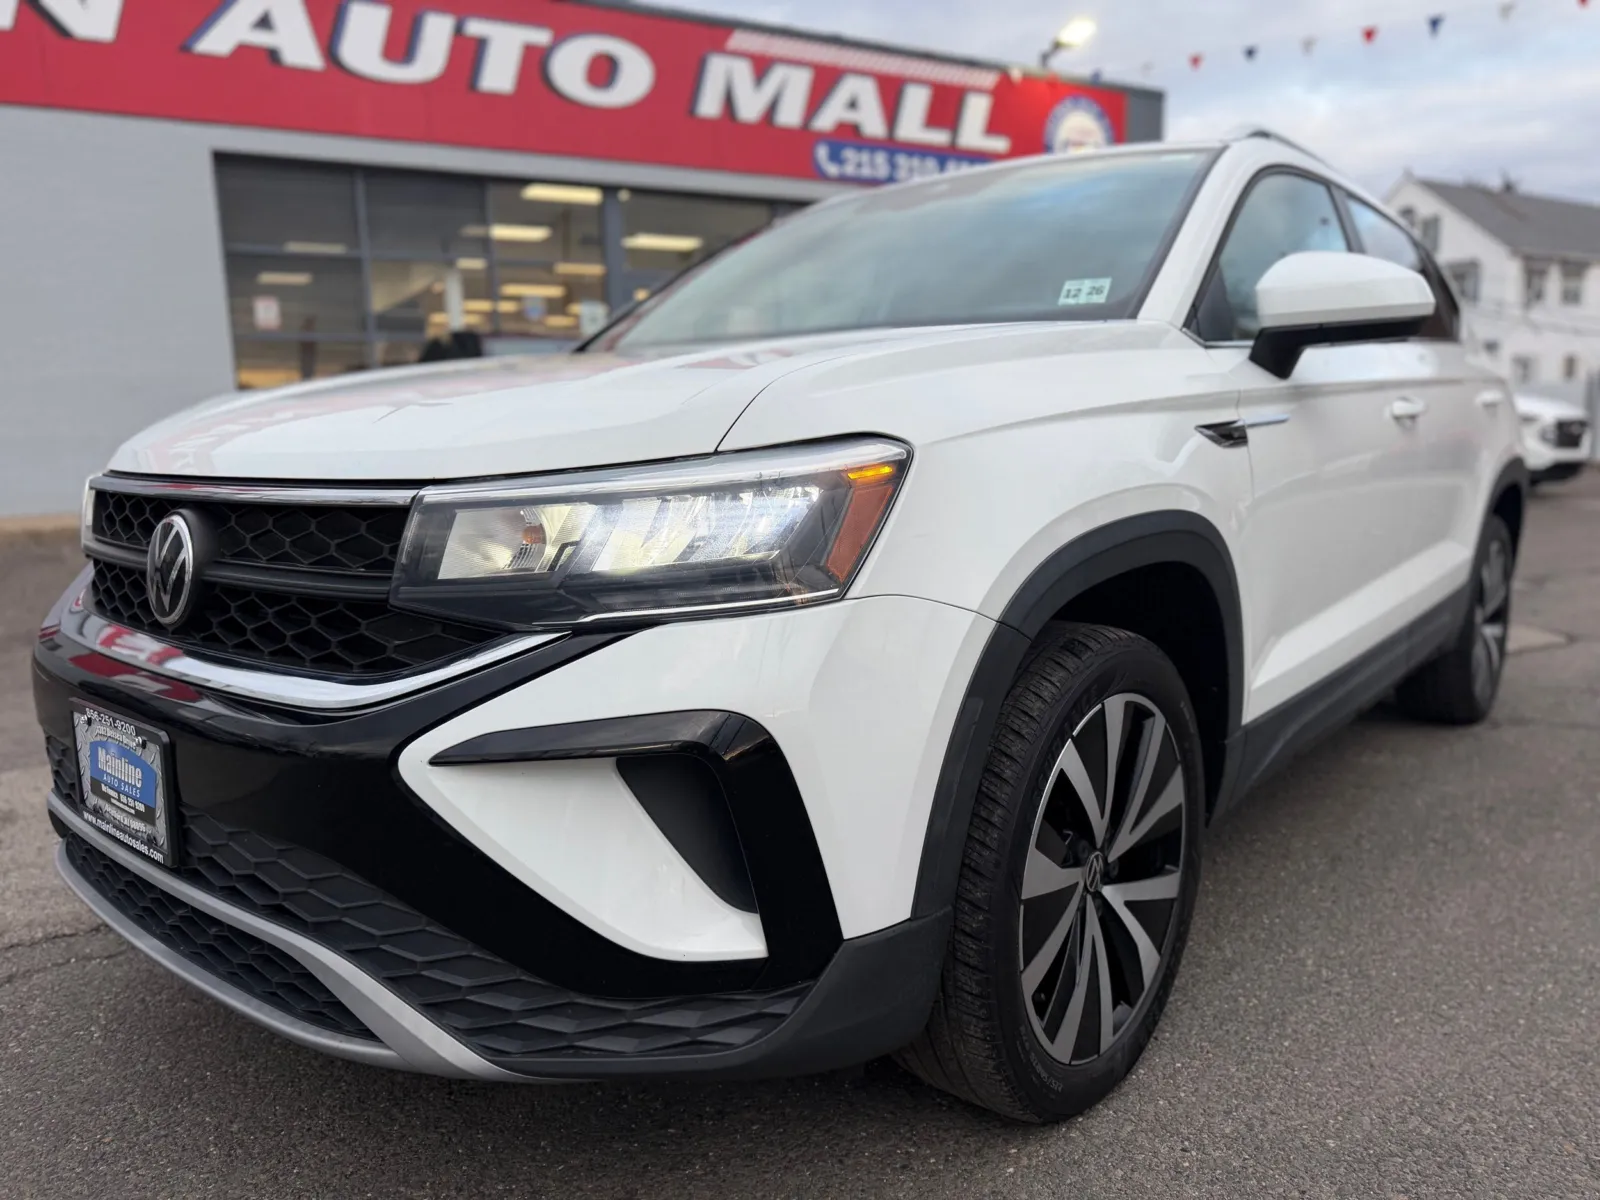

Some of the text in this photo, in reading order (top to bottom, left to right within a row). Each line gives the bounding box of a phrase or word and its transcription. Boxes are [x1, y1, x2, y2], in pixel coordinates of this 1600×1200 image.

[190, 0, 655, 108] AUTO
[693, 51, 1011, 154] MALL
[1063, 285, 1106, 299] 12 26
[85, 707, 136, 736] 856-251-9200
[98, 746, 142, 788] Mainline
[103, 773, 141, 798] AUTO SALES
[83, 811, 164, 864] www.mainlineautosales.com
